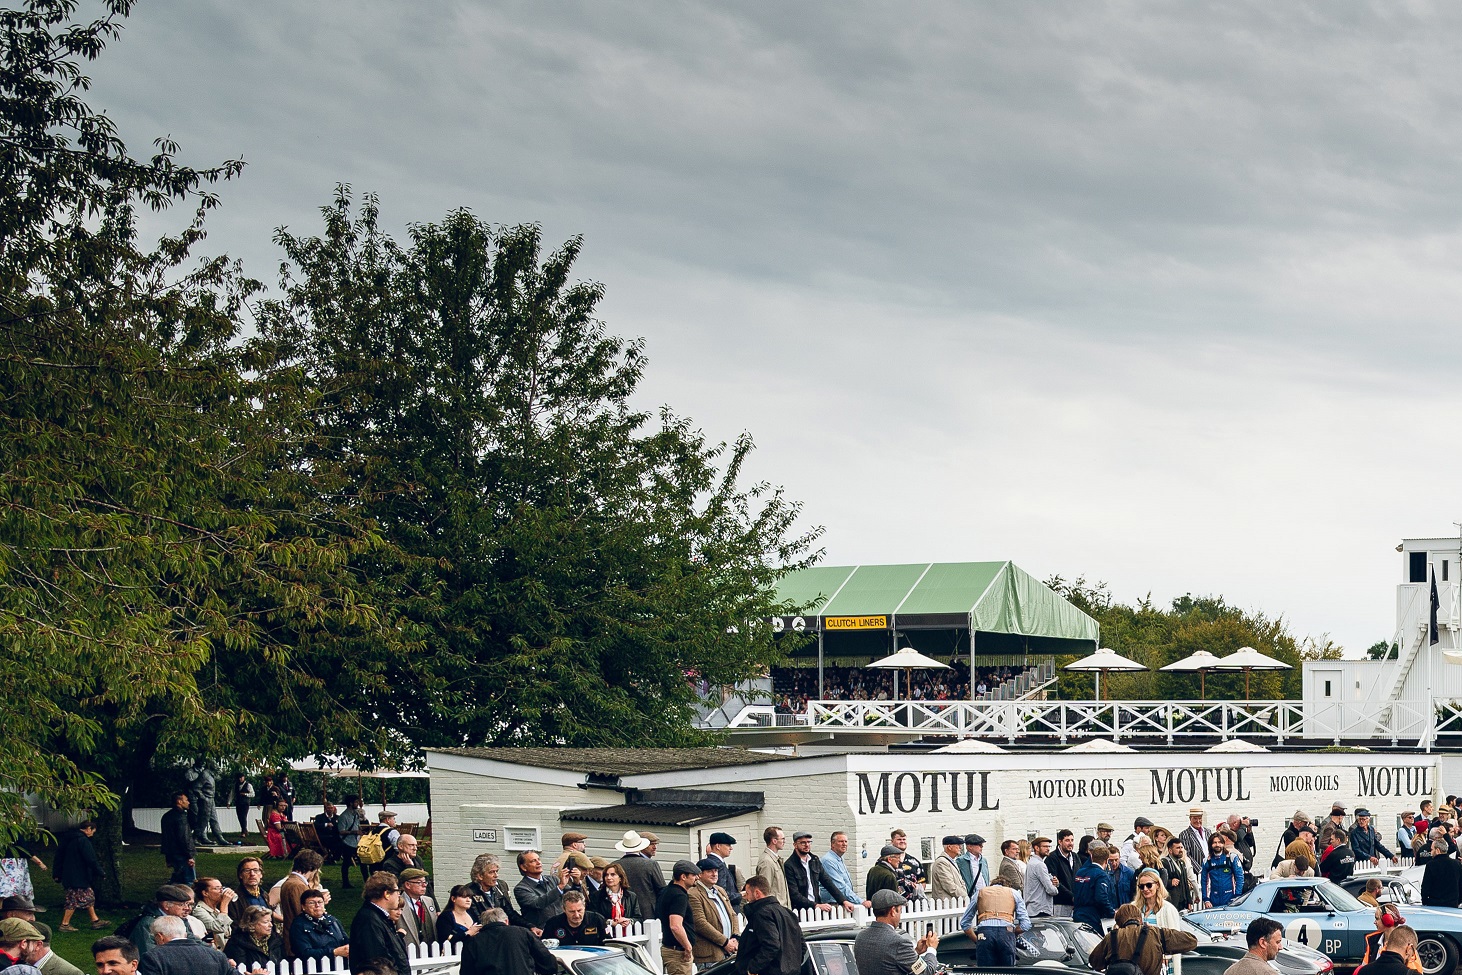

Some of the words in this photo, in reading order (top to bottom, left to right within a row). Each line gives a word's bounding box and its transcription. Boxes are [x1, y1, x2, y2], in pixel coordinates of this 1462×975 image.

[827, 618, 856, 628] CLUTCH
[859, 617, 885, 627] LINERS
[855, 771, 1000, 815] MOTUL
[1028, 779, 1088, 799] MOTOR
[1090, 778, 1125, 798] OILS
[1149, 767, 1251, 805] MOTUL
[1269, 775, 1312, 792] MOTOR
[1314, 774, 1339, 791] OILS
[1356, 766, 1433, 797] MOTUL
[474, 829, 495, 840] LADIES
[1297, 924, 1308, 946] 4
[1325, 939, 1342, 954] BP
